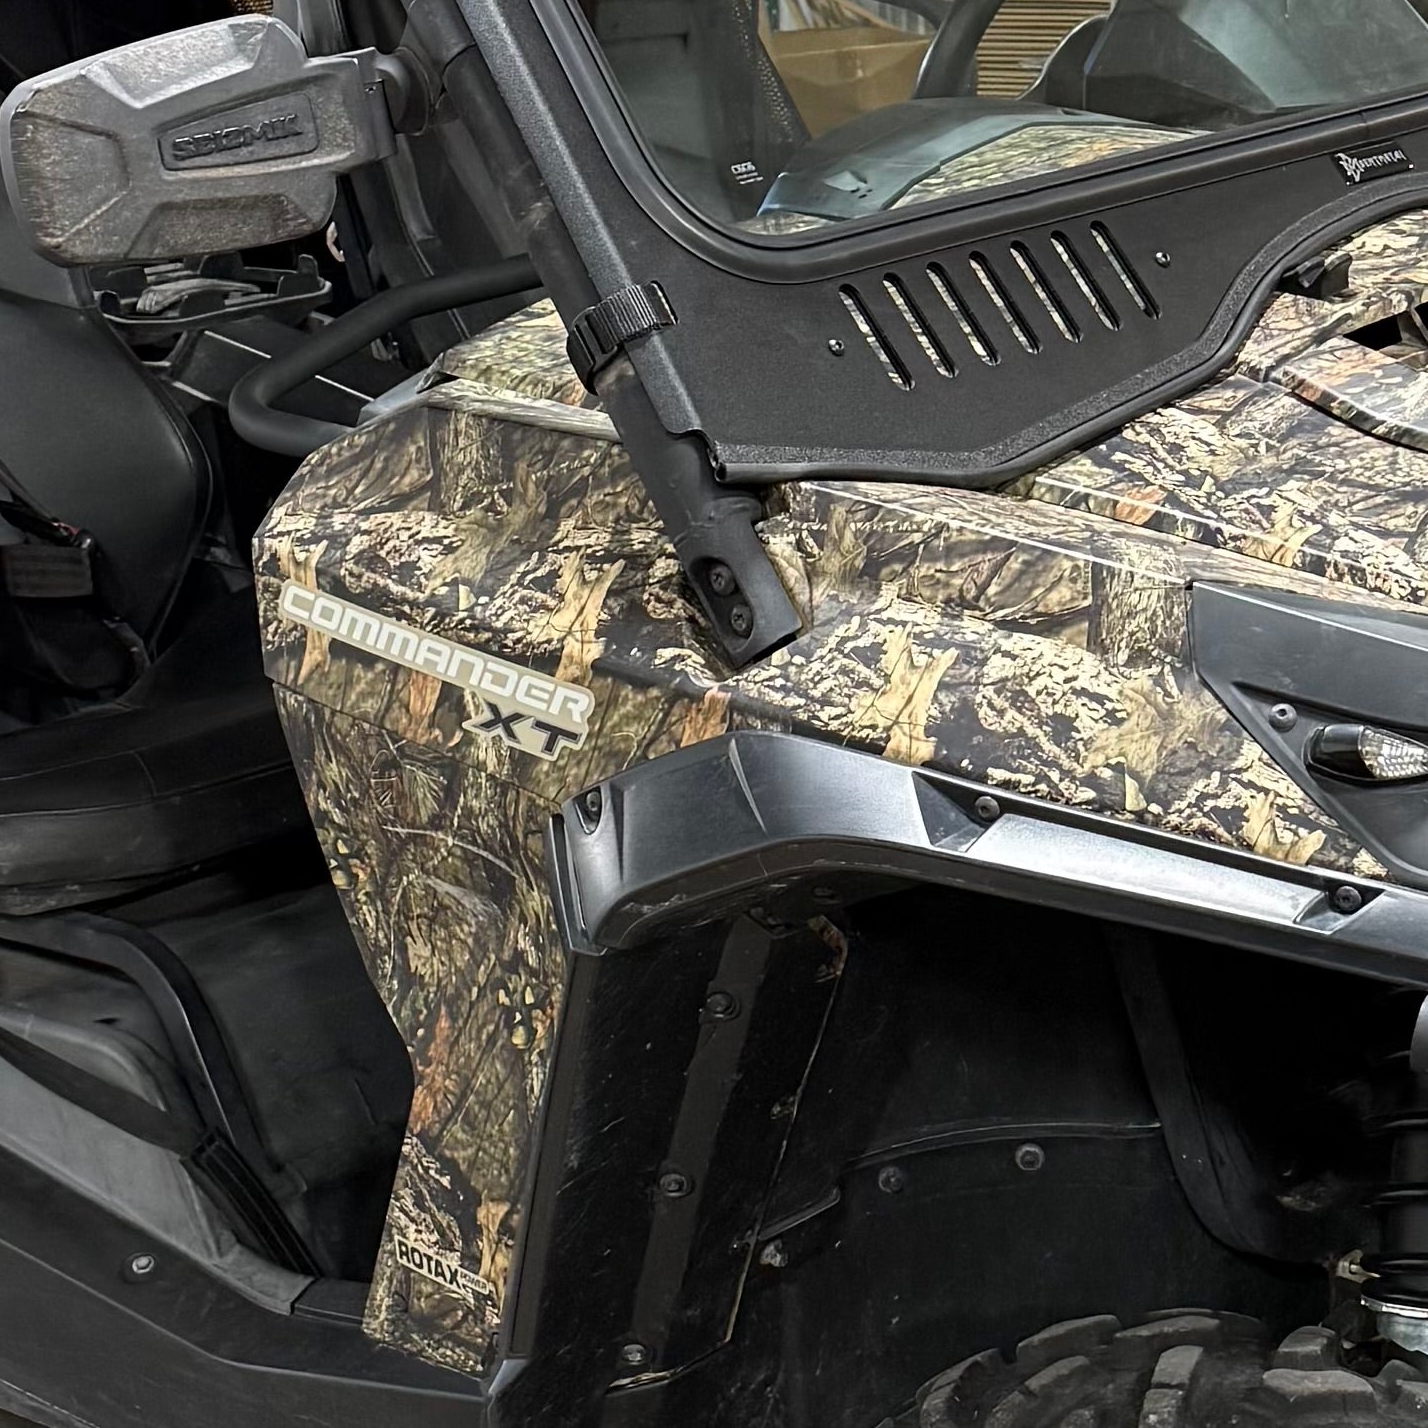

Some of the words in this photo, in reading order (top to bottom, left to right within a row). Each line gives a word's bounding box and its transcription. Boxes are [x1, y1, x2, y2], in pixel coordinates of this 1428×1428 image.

[282, 584, 592, 723] COMMANDER
[473, 701, 582, 756] XT
[397, 1237, 462, 1291] ROTAX
